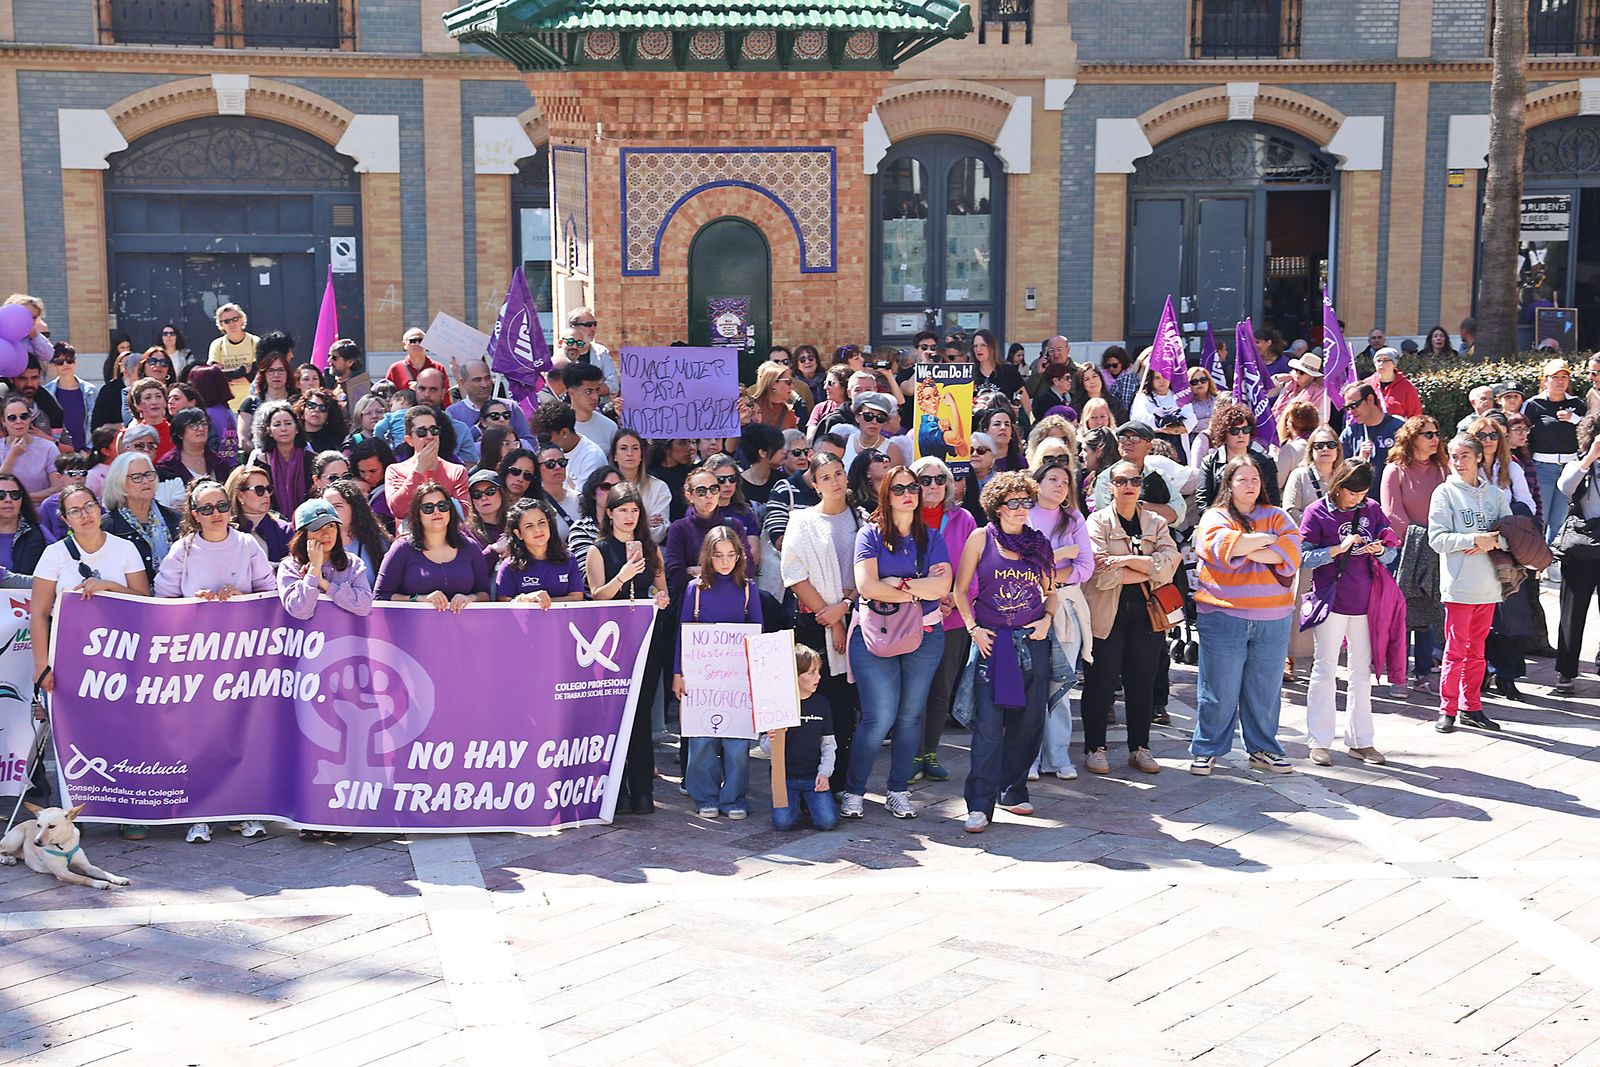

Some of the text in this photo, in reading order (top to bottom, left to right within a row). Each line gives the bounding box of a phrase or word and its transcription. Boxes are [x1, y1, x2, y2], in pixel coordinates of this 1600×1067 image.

[1527, 202, 1567, 211] RUBEN'S
[1528, 214, 1549, 222] BEER
[620, 352, 639, 378] NO
[670, 358, 730, 380] MUJER
[918, 364, 973, 379] We Can Do It!
[641, 379, 686, 402] PARA
[83, 627, 325, 664] SIN FEMINISMO
[692, 630, 709, 646] NO
[78, 668, 326, 704] NO HAY CAMBIO.
[555, 679, 631, 691] COLEGIO PROFESIONA
[564, 691, 587, 700] TRABAJO
[587, 689, 605, 698] SOCIAL
[605, 688, 612, 696] DE
[613, 687, 630, 696] HUEL
[407, 733, 616, 770] NO HAY CAMBI
[110, 759, 189, 775] Andalucía
[67, 784, 185, 797] Consejo Andaluz de Colegios
[328, 774, 609, 814] SIN TRABAJO SOCIA
[69, 793, 189, 807] ofesionales de Trabajo Social
